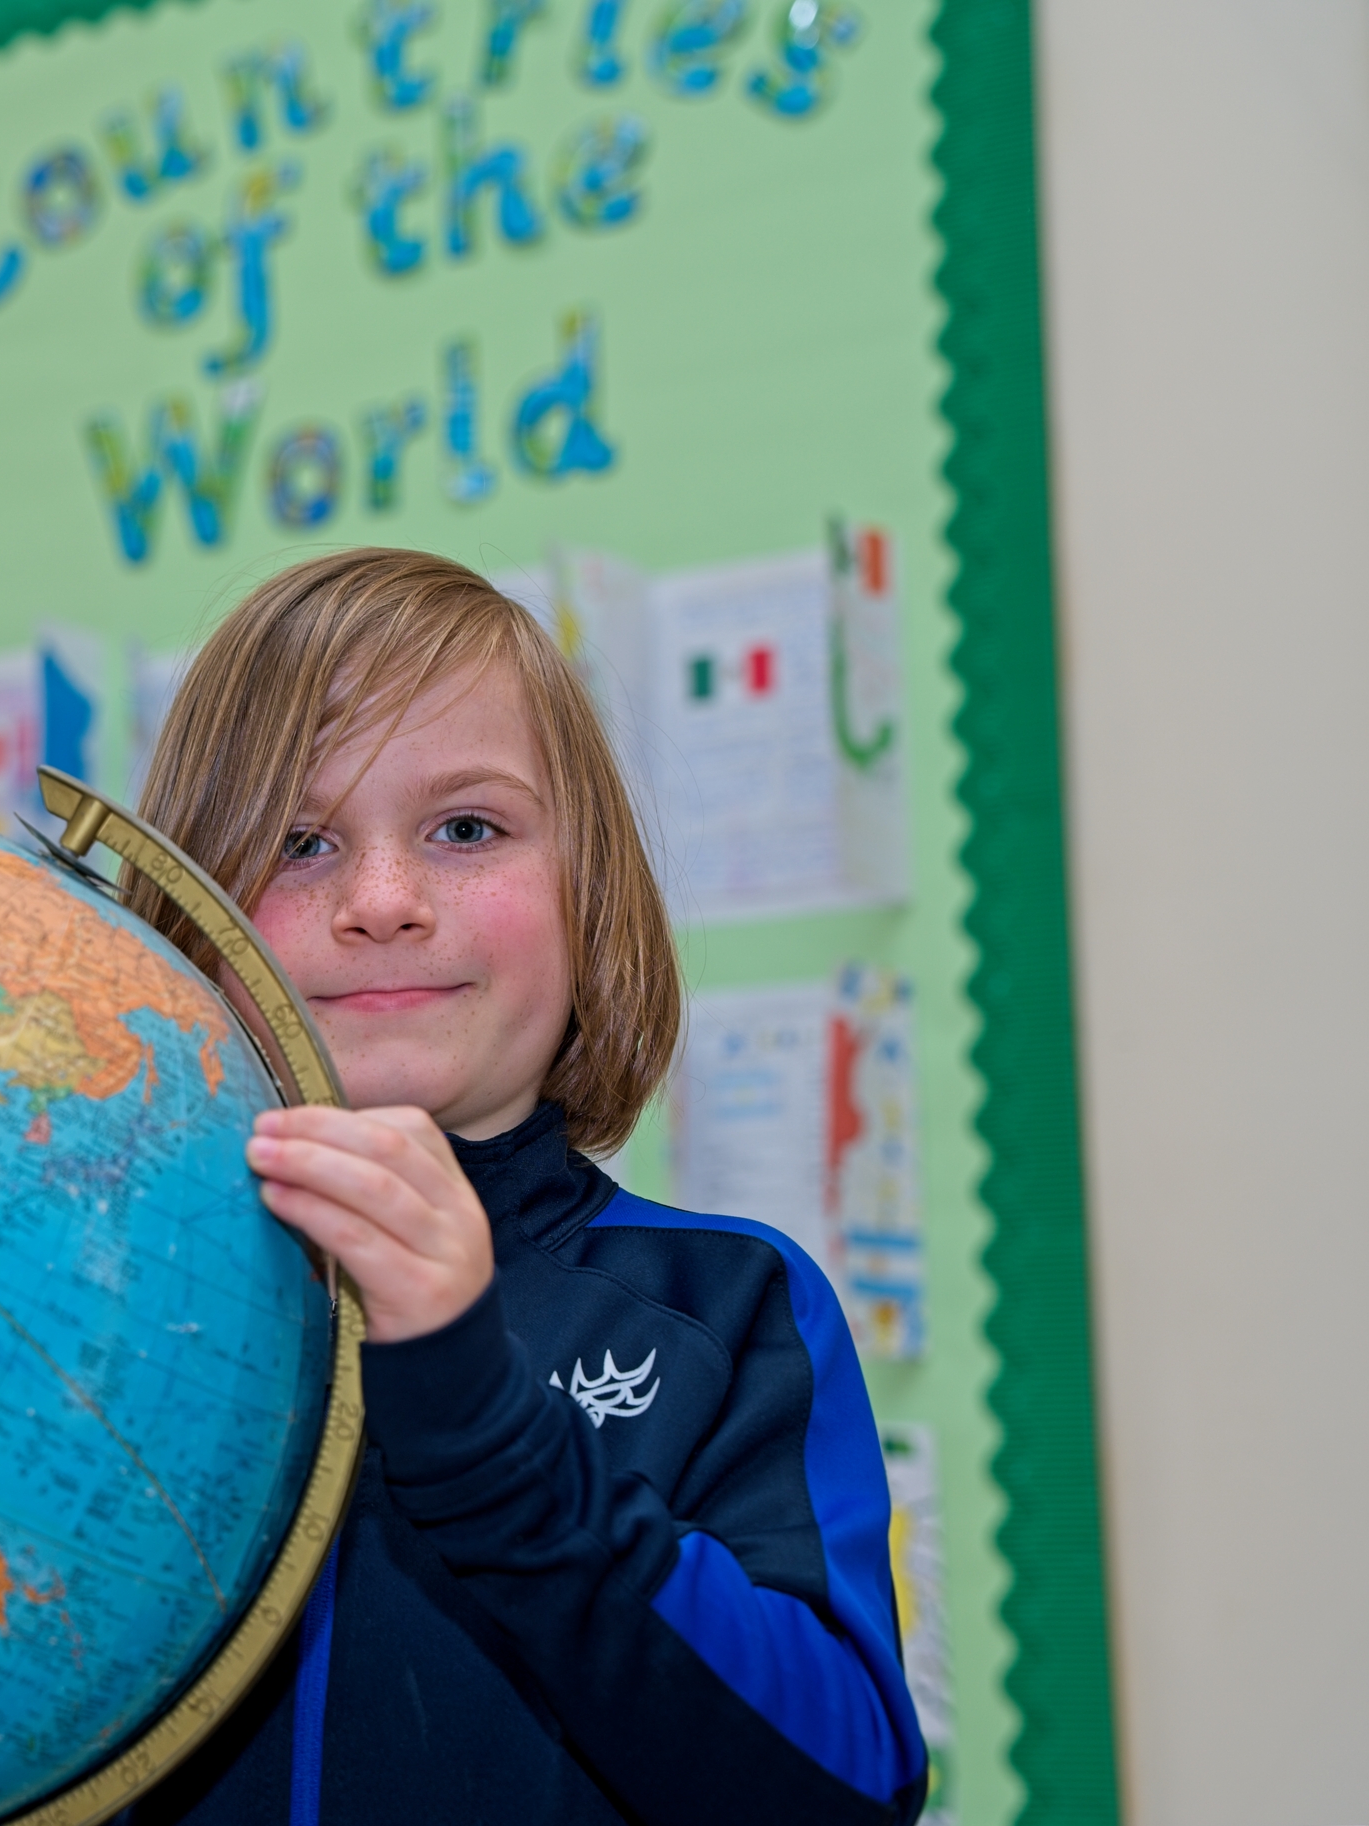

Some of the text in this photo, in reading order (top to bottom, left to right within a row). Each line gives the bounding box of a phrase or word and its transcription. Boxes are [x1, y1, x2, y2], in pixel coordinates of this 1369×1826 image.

[137, 97, 651, 379] of the
[87, 306, 616, 566] World
[150, 852, 185, 885] 80
[218, 925, 250, 956] 70
[273, 1003, 304, 1041] 60
[334, 1402, 360, 1442] 20
